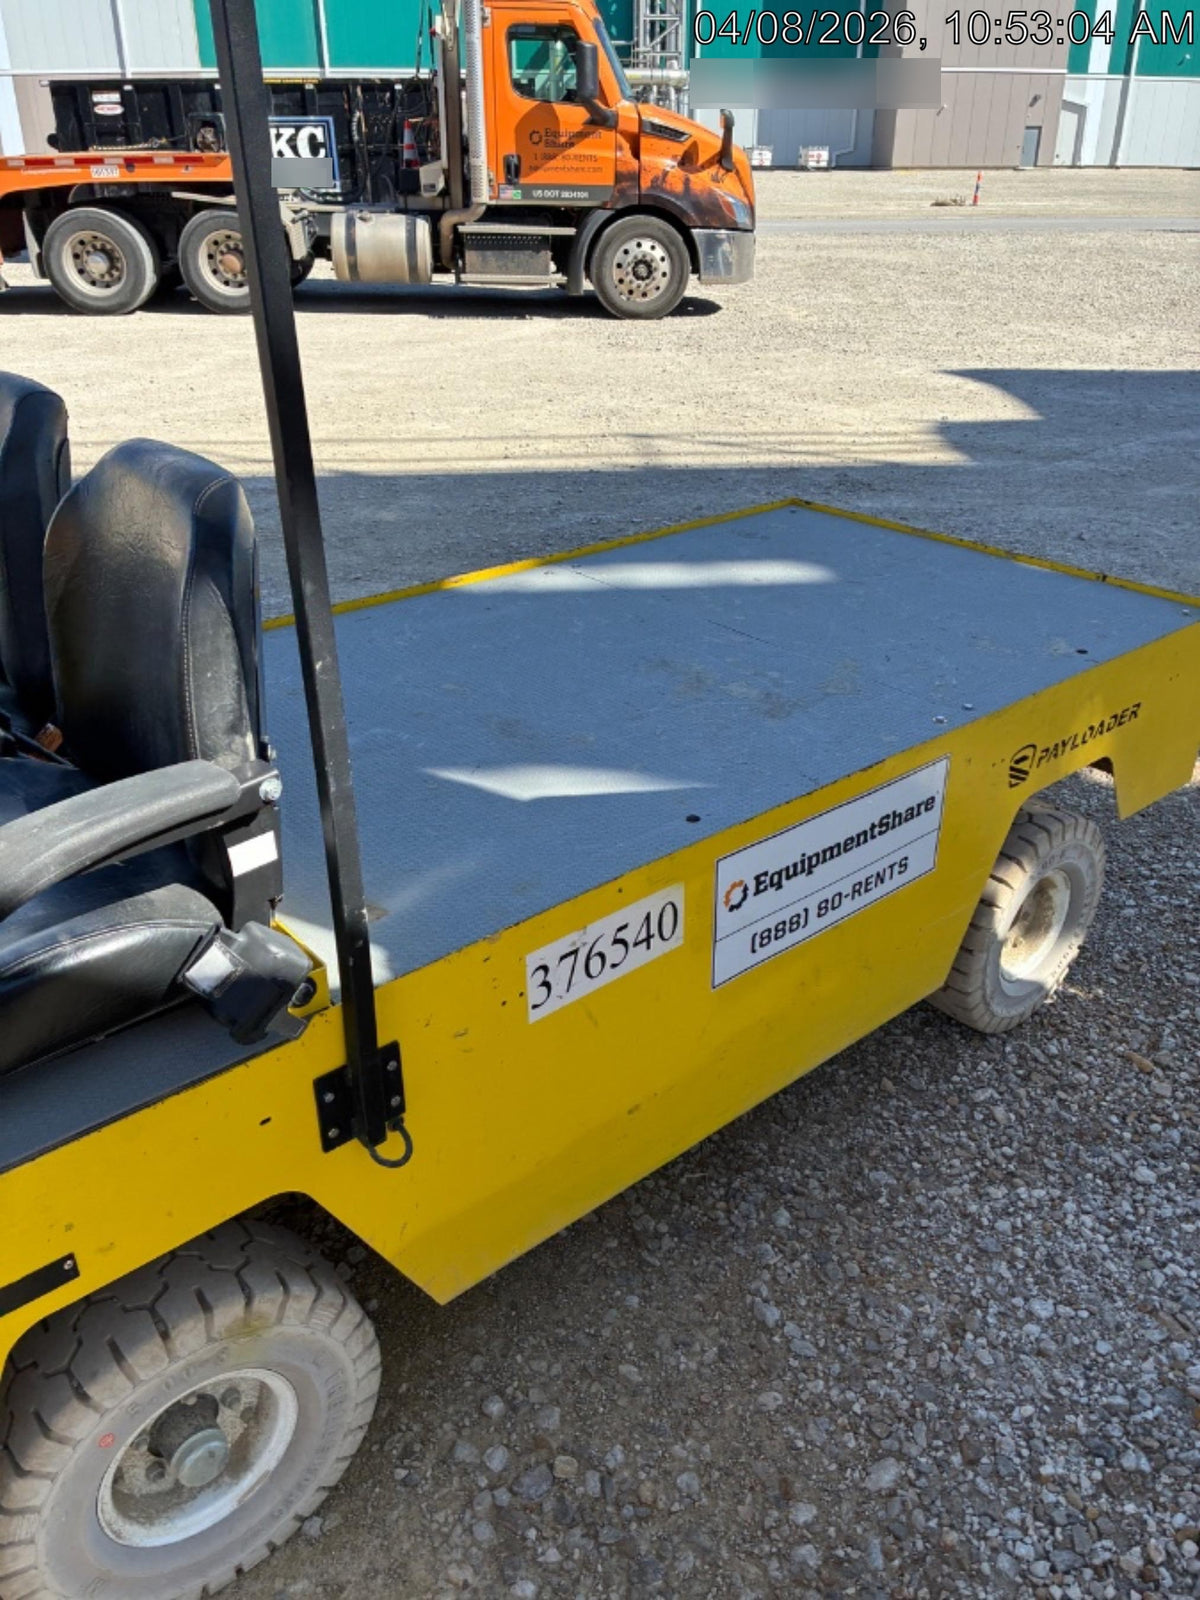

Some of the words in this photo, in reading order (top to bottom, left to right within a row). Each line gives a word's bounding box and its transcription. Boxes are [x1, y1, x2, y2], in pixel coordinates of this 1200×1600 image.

[532, 190, 543, 198] US
[544, 190, 560, 198] DOT
[1036, 702, 1142, 768] PAYLOADER
[752, 794, 937, 897] EquipmentShare
[750, 909, 809, 954] (888)
[817, 856, 910, 919] 80-RENTS
[530, 901, 679, 1010] 376540
